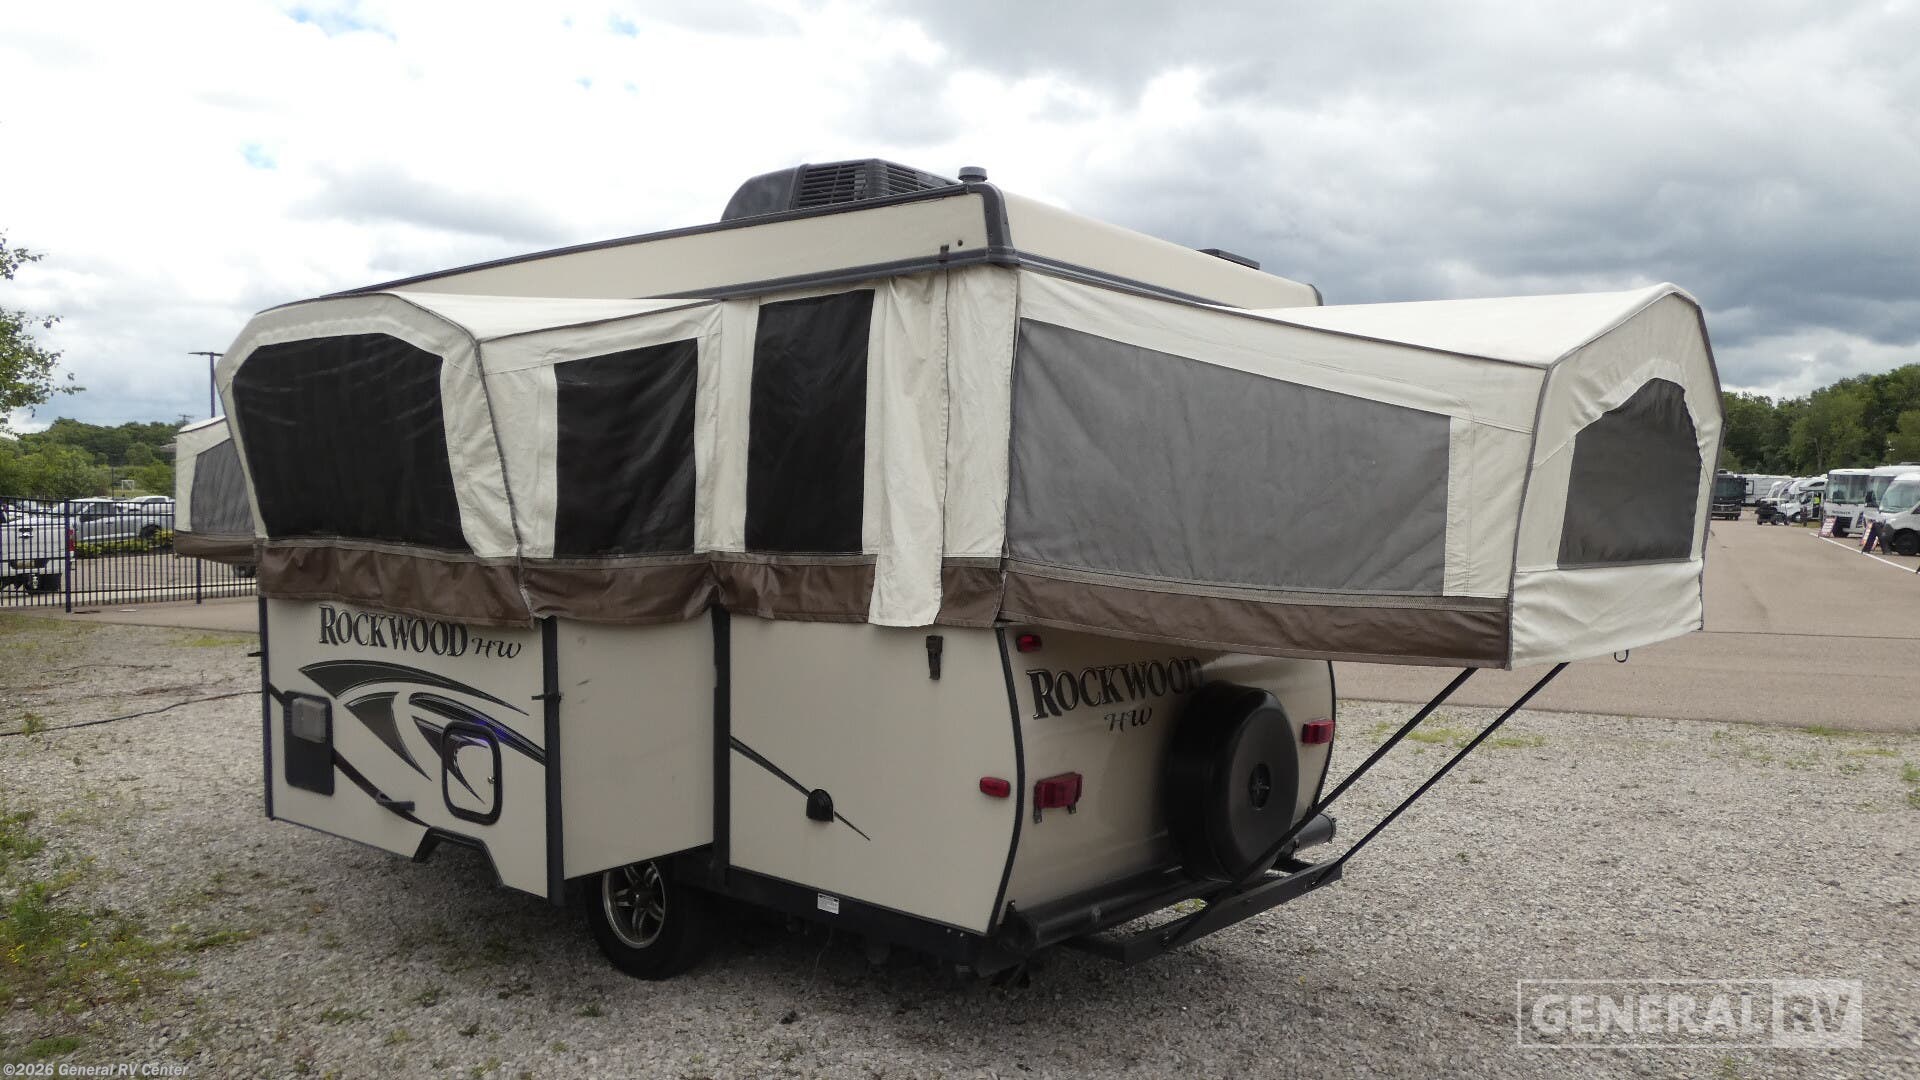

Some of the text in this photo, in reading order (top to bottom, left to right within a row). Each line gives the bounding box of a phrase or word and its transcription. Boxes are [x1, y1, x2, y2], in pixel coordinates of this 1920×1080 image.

[318, 605, 523, 659] ROCKWOOD HW
[1104, 707, 1153, 732] HW
